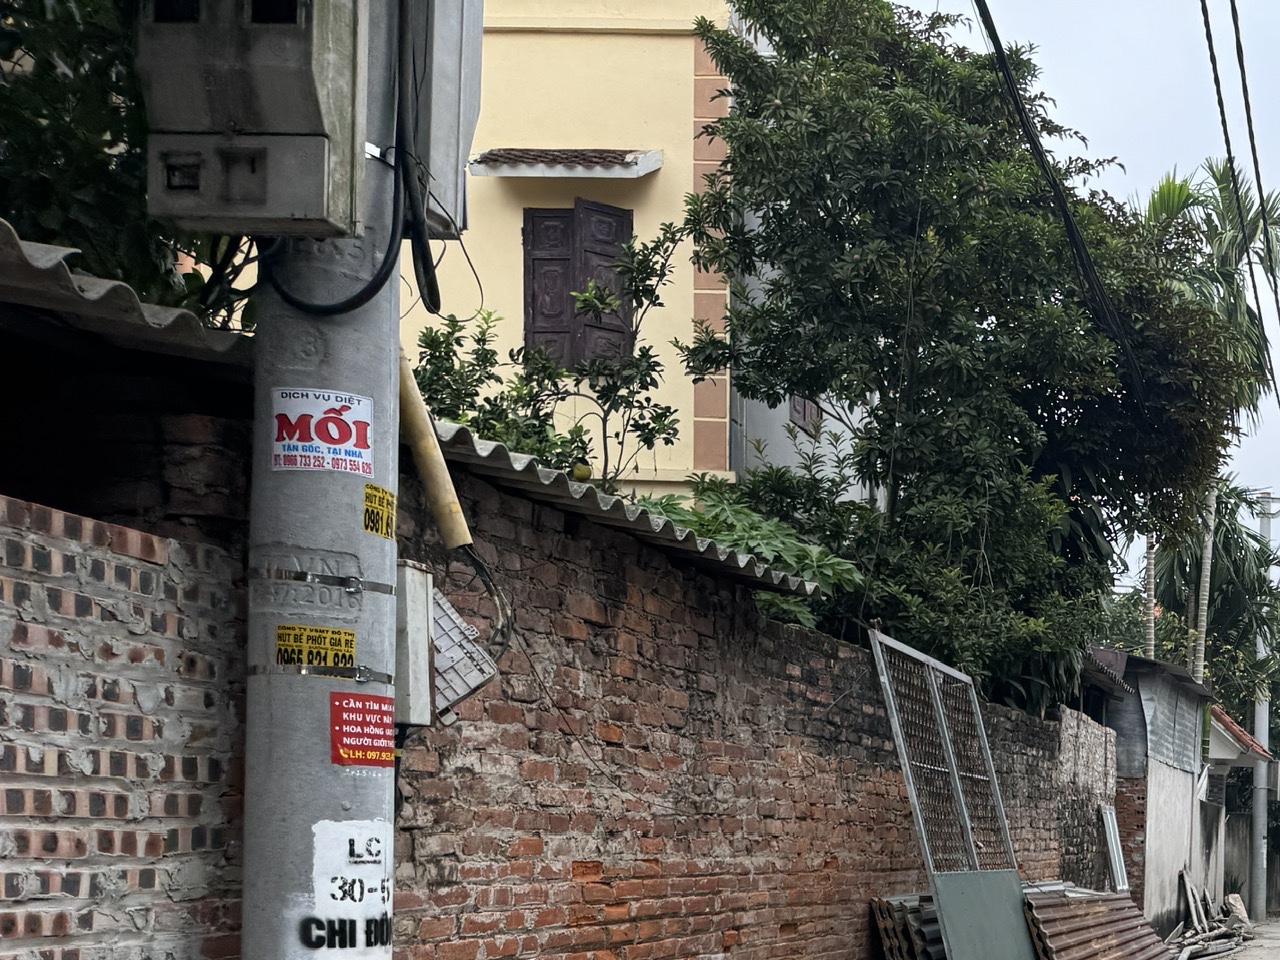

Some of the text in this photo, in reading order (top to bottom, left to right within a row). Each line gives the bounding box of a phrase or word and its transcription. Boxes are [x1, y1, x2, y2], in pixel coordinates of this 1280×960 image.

[281, 391, 363, 406] DỊCH VỤ DIỆT
[275, 404, 370, 450] MỐI
[331, 457, 347, 470] 0973
[342, 698, 363, 709] CẦN
[365, 701, 380, 710] TÌM
[342, 712, 363, 722] KHU
[365, 714, 382, 724] VỰC
[342, 725, 363, 734] HOA
[363, 725, 384, 736] HỒNG
[342, 736, 373, 747] NGƯỜI
[349, 750, 366, 759] LH:
[299, 916, 358, 950] CHI
